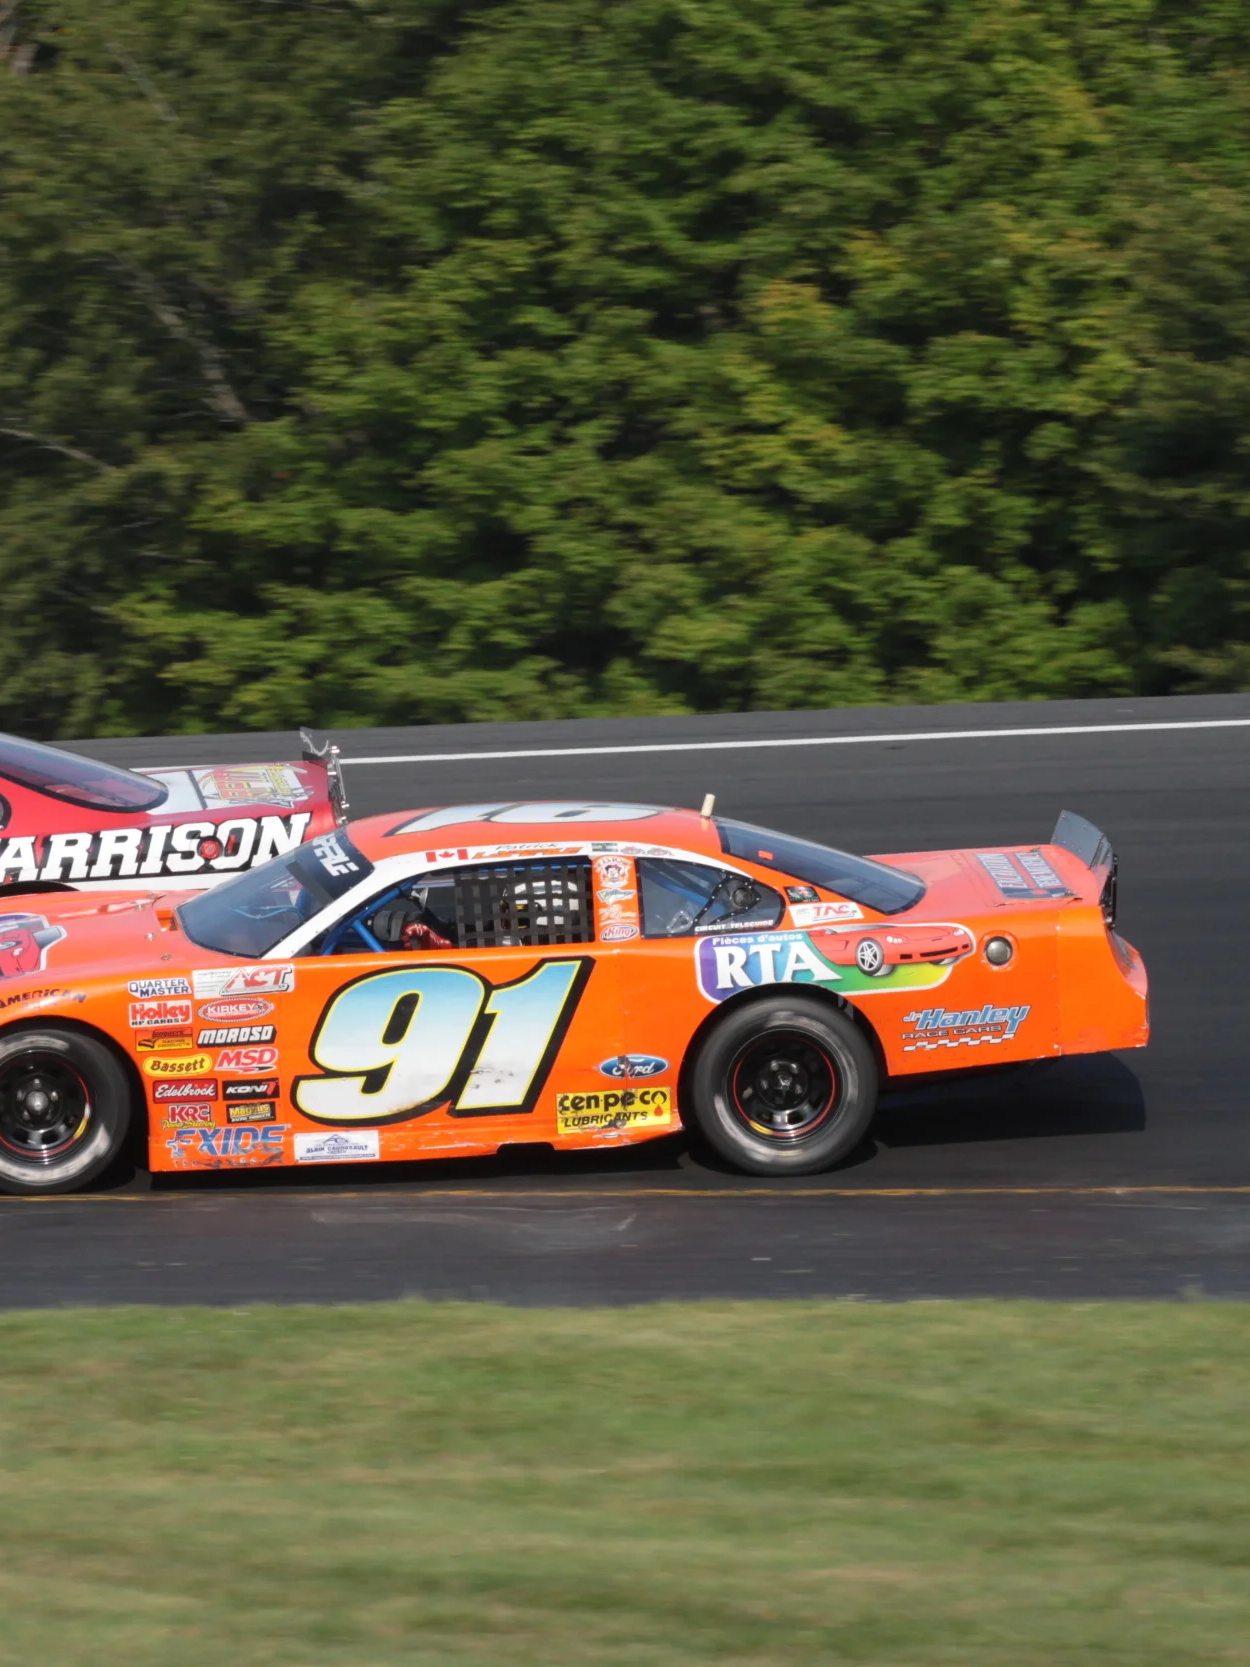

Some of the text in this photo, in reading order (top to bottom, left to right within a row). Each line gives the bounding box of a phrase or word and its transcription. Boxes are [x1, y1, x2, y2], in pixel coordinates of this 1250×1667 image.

[813, 904, 850, 917] TAC
[607, 925, 631, 938] King
[694, 923, 727, 933] CIRCUIT
[712, 933, 804, 946] Pièces d'autos
[713, 940, 844, 990] RTA
[129, 979, 186, 993] QUARTER
[222, 965, 289, 992] ACT
[139, 987, 189, 998] MASTER
[130, 1003, 191, 1023] Holley
[207, 1004, 254, 1014] KIRKEY
[146, 1018, 180, 1026] CARBS
[903, 1004, 1032, 1034] Jr Hanley
[197, 1025, 275, 1045] MOROSO
[902, 1025, 1002, 1040] RACE CARS
[292, 956, 592, 1125] 91
[150, 1057, 206, 1073] Bassett
[217, 1048, 279, 1068] MSD
[154, 1084, 217, 1099] Edelbrock
[225, 1085, 268, 1095] KONI
[169, 1105, 211, 1123] KRC
[563, 1111, 649, 1128] LUBRICANTS
